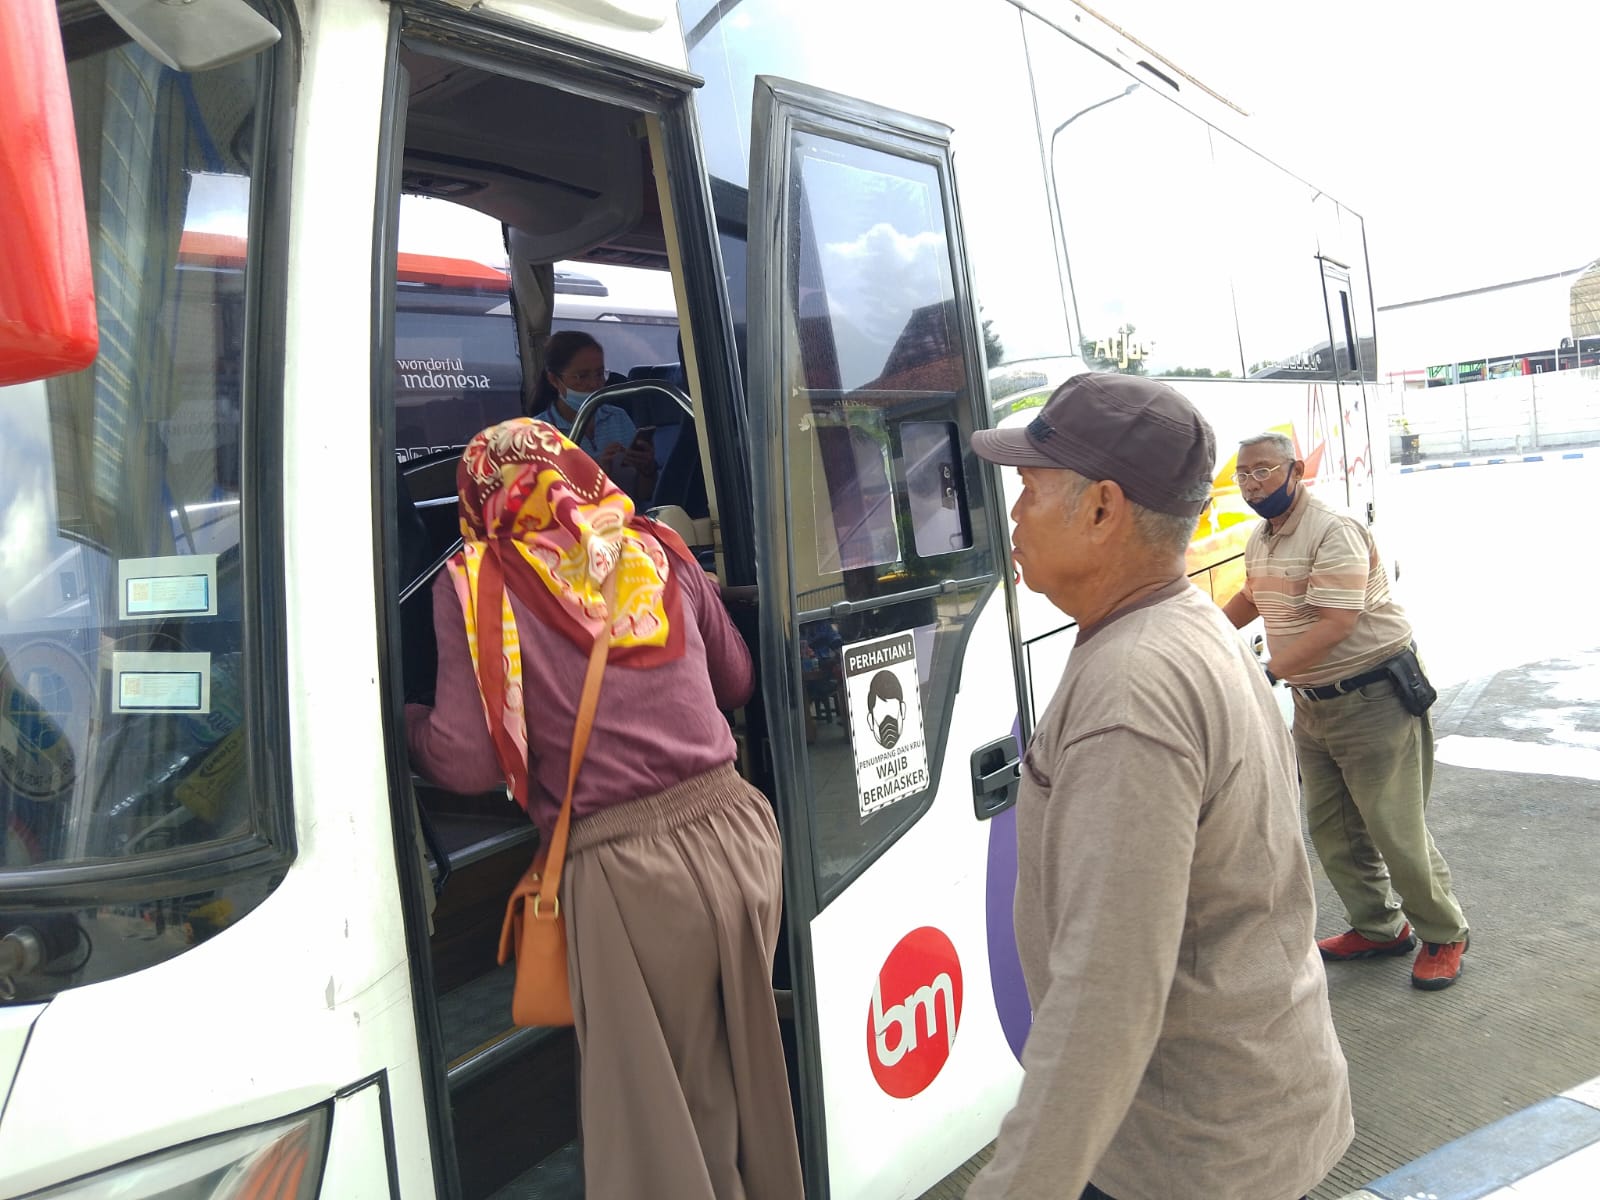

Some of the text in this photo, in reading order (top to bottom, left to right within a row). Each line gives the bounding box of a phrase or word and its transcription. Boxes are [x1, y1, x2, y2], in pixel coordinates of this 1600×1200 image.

[397, 357, 464, 371] wonderful
[401, 371, 491, 389] indonesia
[849, 645, 907, 671] PERHATIAN
[859, 751, 896, 769] PENUMPANG
[876, 756, 908, 779] WAJIB
[863, 768, 925, 806] BERMASKER
[872, 972, 957, 1067] bm
